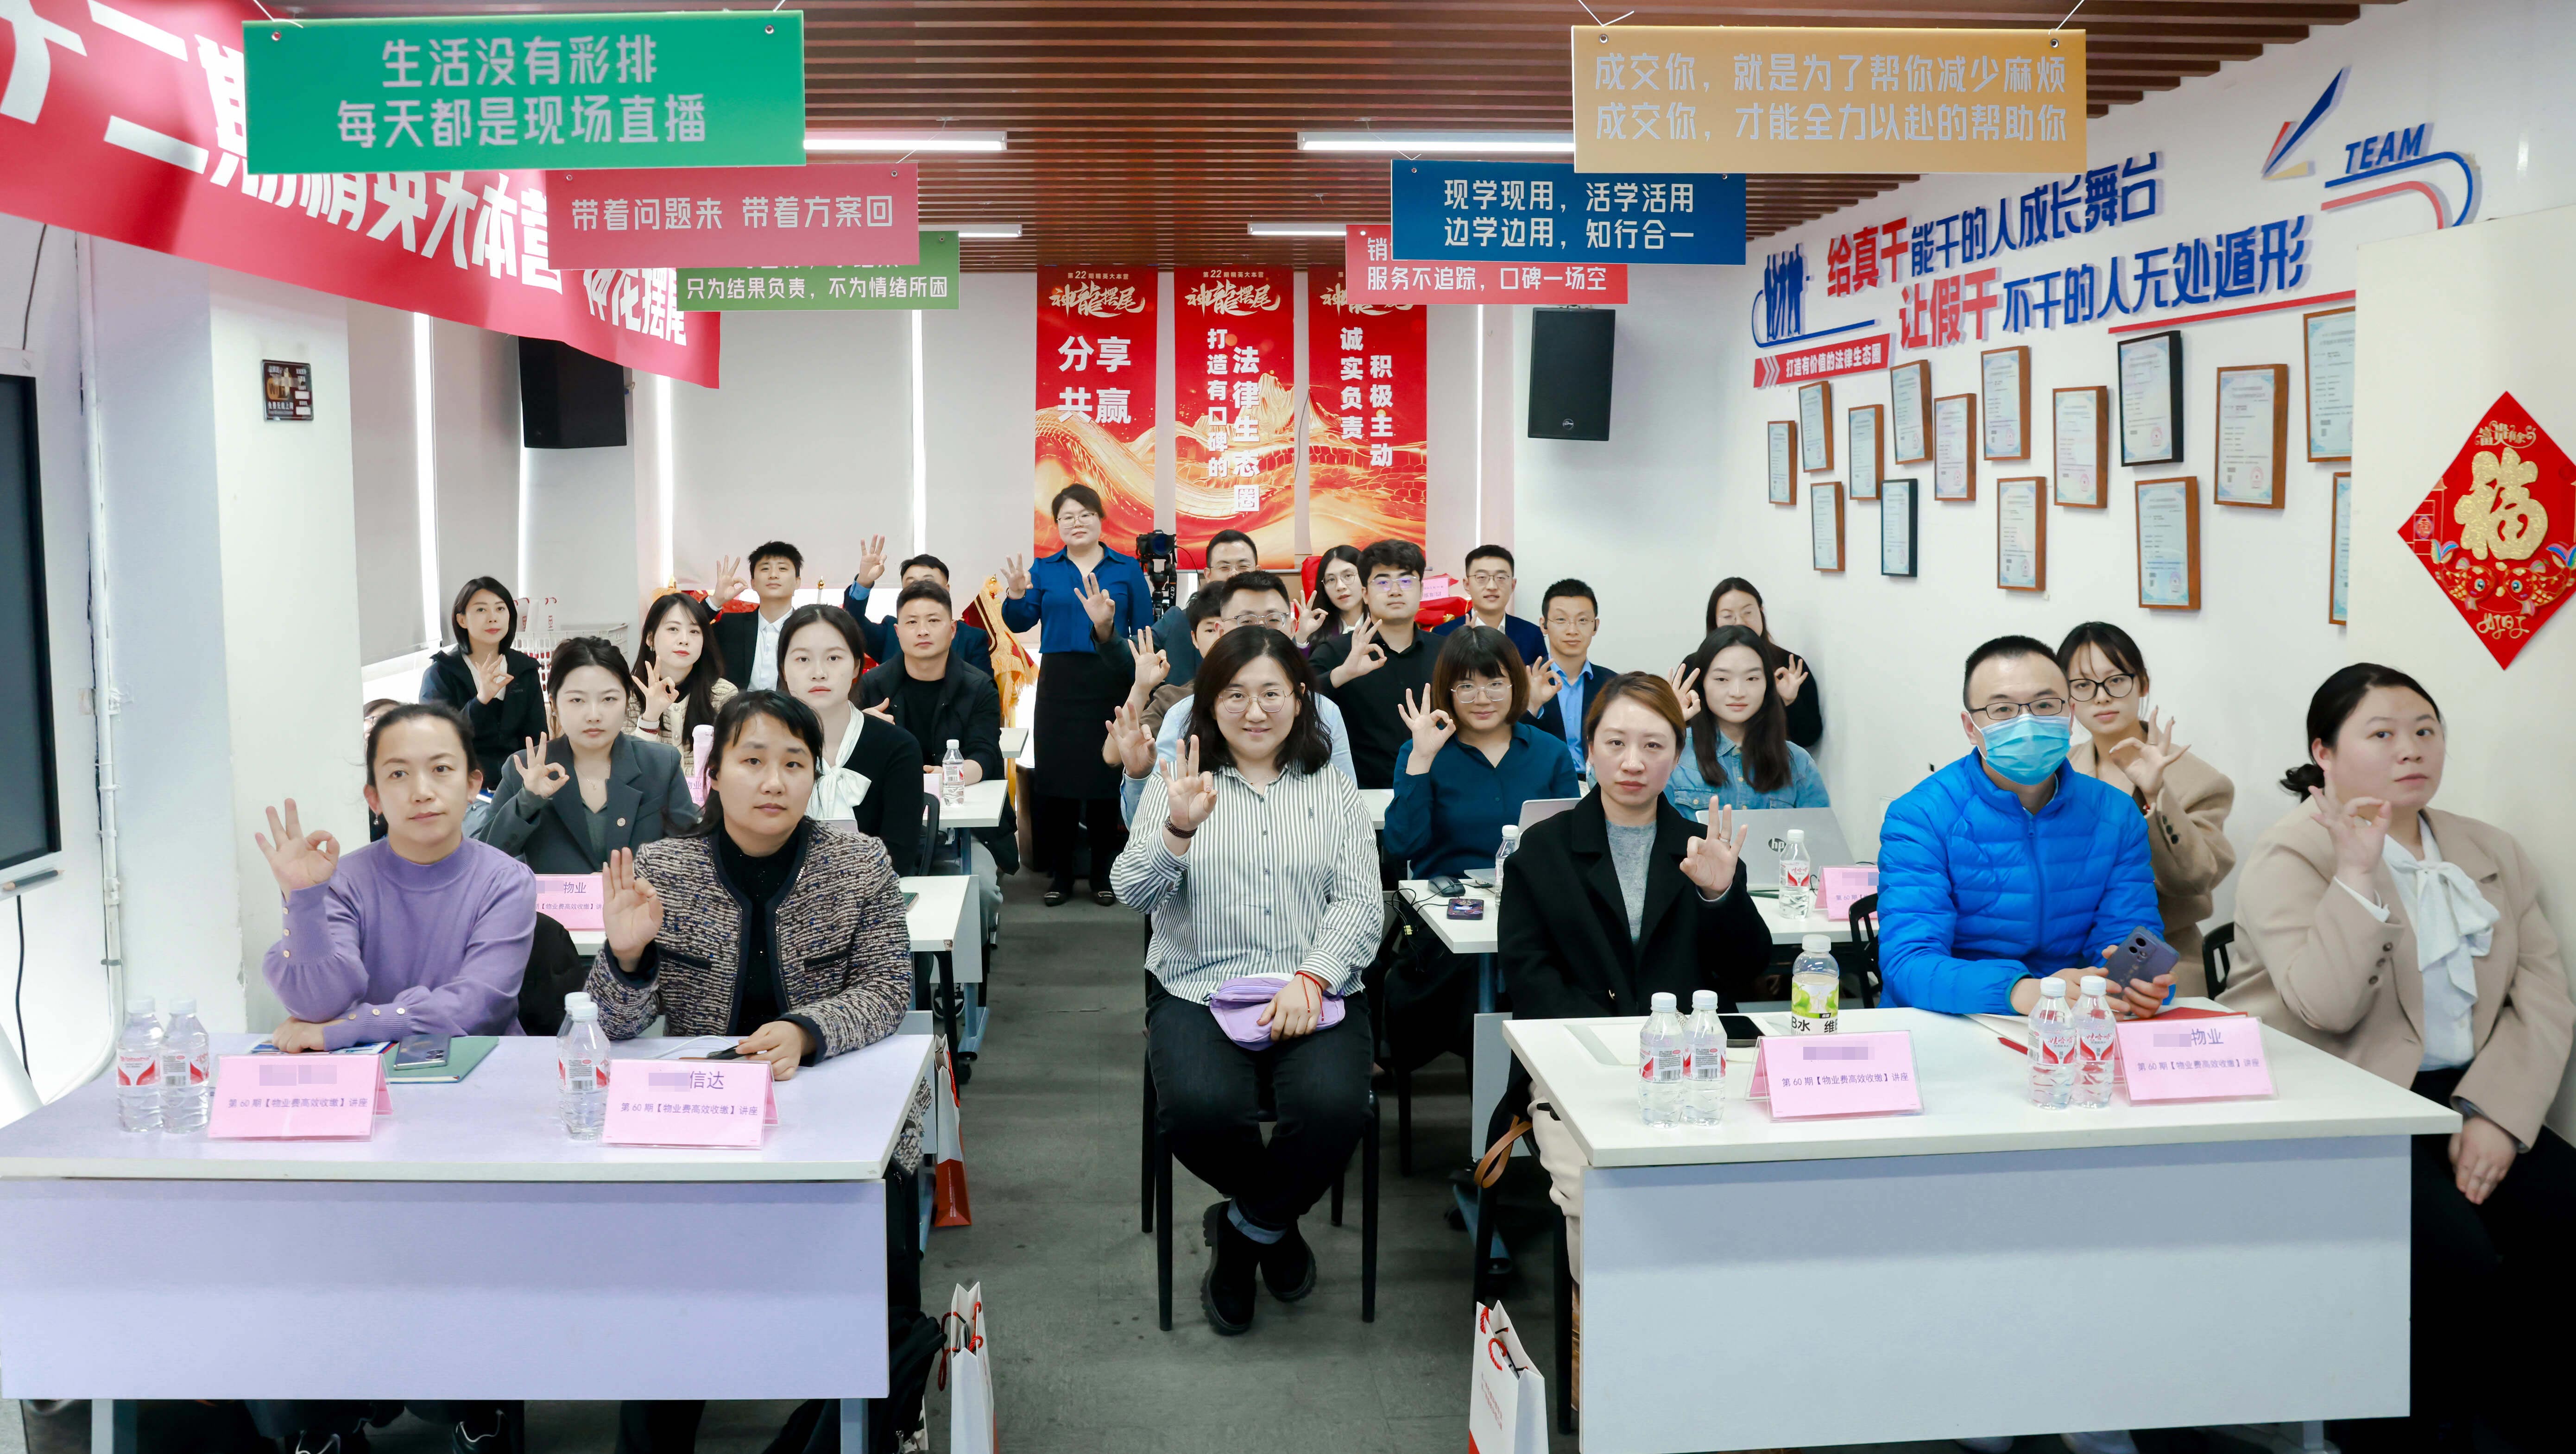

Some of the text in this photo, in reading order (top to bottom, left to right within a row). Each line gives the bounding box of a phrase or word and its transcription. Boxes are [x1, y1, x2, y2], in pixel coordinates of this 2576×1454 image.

[381, 35, 658, 89] 生活没有彩排
[1594, 53, 2066, 94] 成交你，就是为了帮你减少麻烦
[336, 94, 706, 149] 每天都是现场直播
[1595, 101, 2067, 143] 成交你，才能全力以赴的帮助你
[2345, 123, 2426, 174] TEAM
[572, 195, 894, 231] 带着问题来 带着方案回
[1444, 178, 1696, 214] 现学现用，活学活用
[1367, 237, 1392, 261] 销
[1444, 216, 1696, 249] 边学边用，知行合一
[687, 277, 948, 300] 只为结果负责，不为情绪所困
[1367, 266, 1607, 291] 服务不追踪，口碑一场空
[1057, 335, 1132, 373] 分享
[1786, 343, 1882, 378] 打造有价值的法律生态圈
[1207, 328, 1229, 478] 打造有口碑的
[1340, 327, 1364, 441] 诚实负责
[1057, 386, 1132, 425] 共赢
[1369, 355, 1394, 468] 积极主动
[1232, 345, 1260, 512] 法律生态圈
[2453, 447, 2549, 560] 福
[1771, 837, 1786, 852] hp
